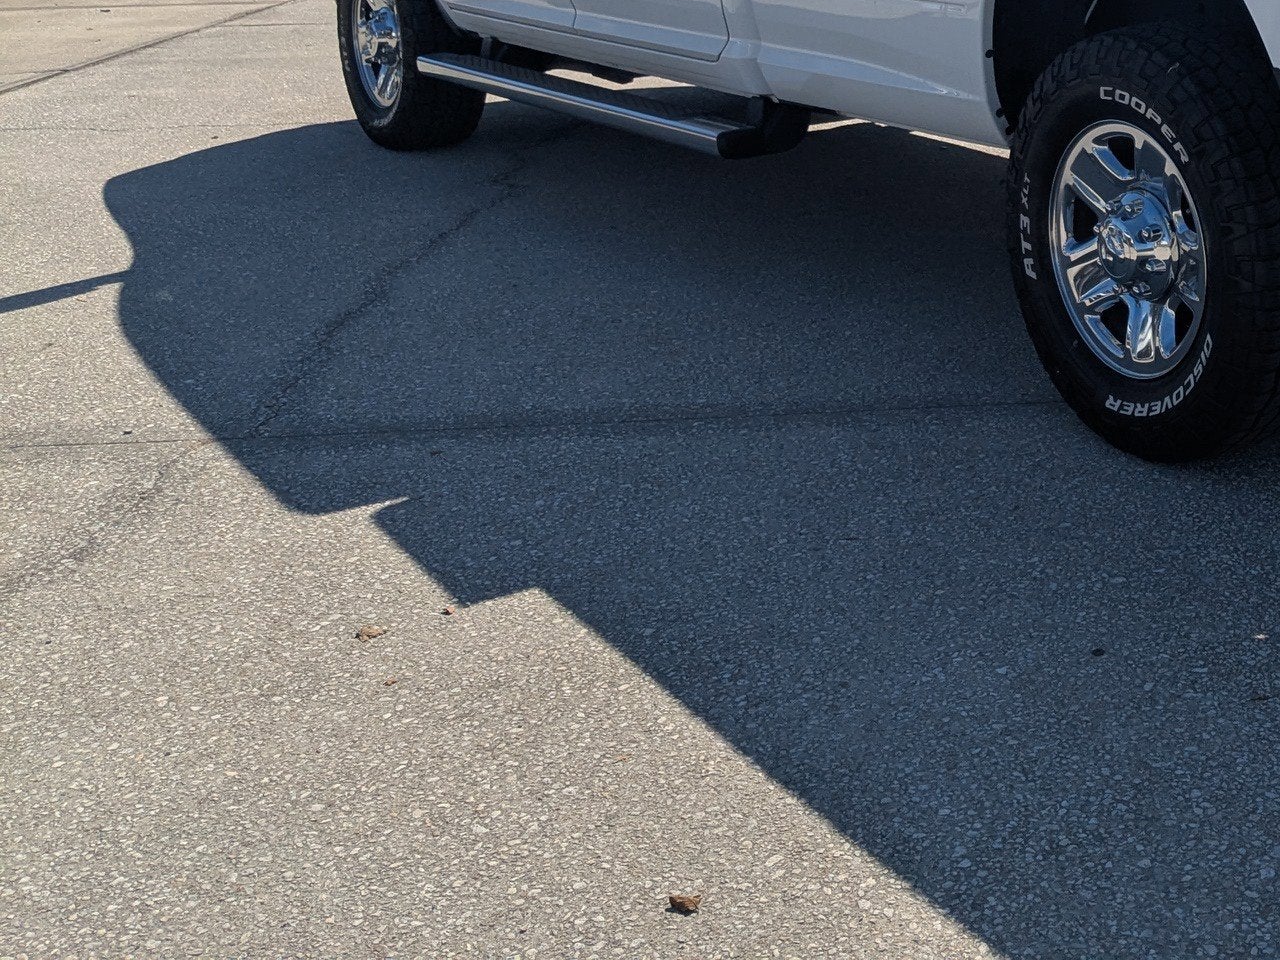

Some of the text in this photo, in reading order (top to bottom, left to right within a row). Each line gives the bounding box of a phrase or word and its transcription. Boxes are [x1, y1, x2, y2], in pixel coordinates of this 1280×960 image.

[1100, 86, 1190, 164] COOPER
[1020, 172, 1037, 280] AT3 XLT
[1104, 332, 1213, 418] DISCOVERER
